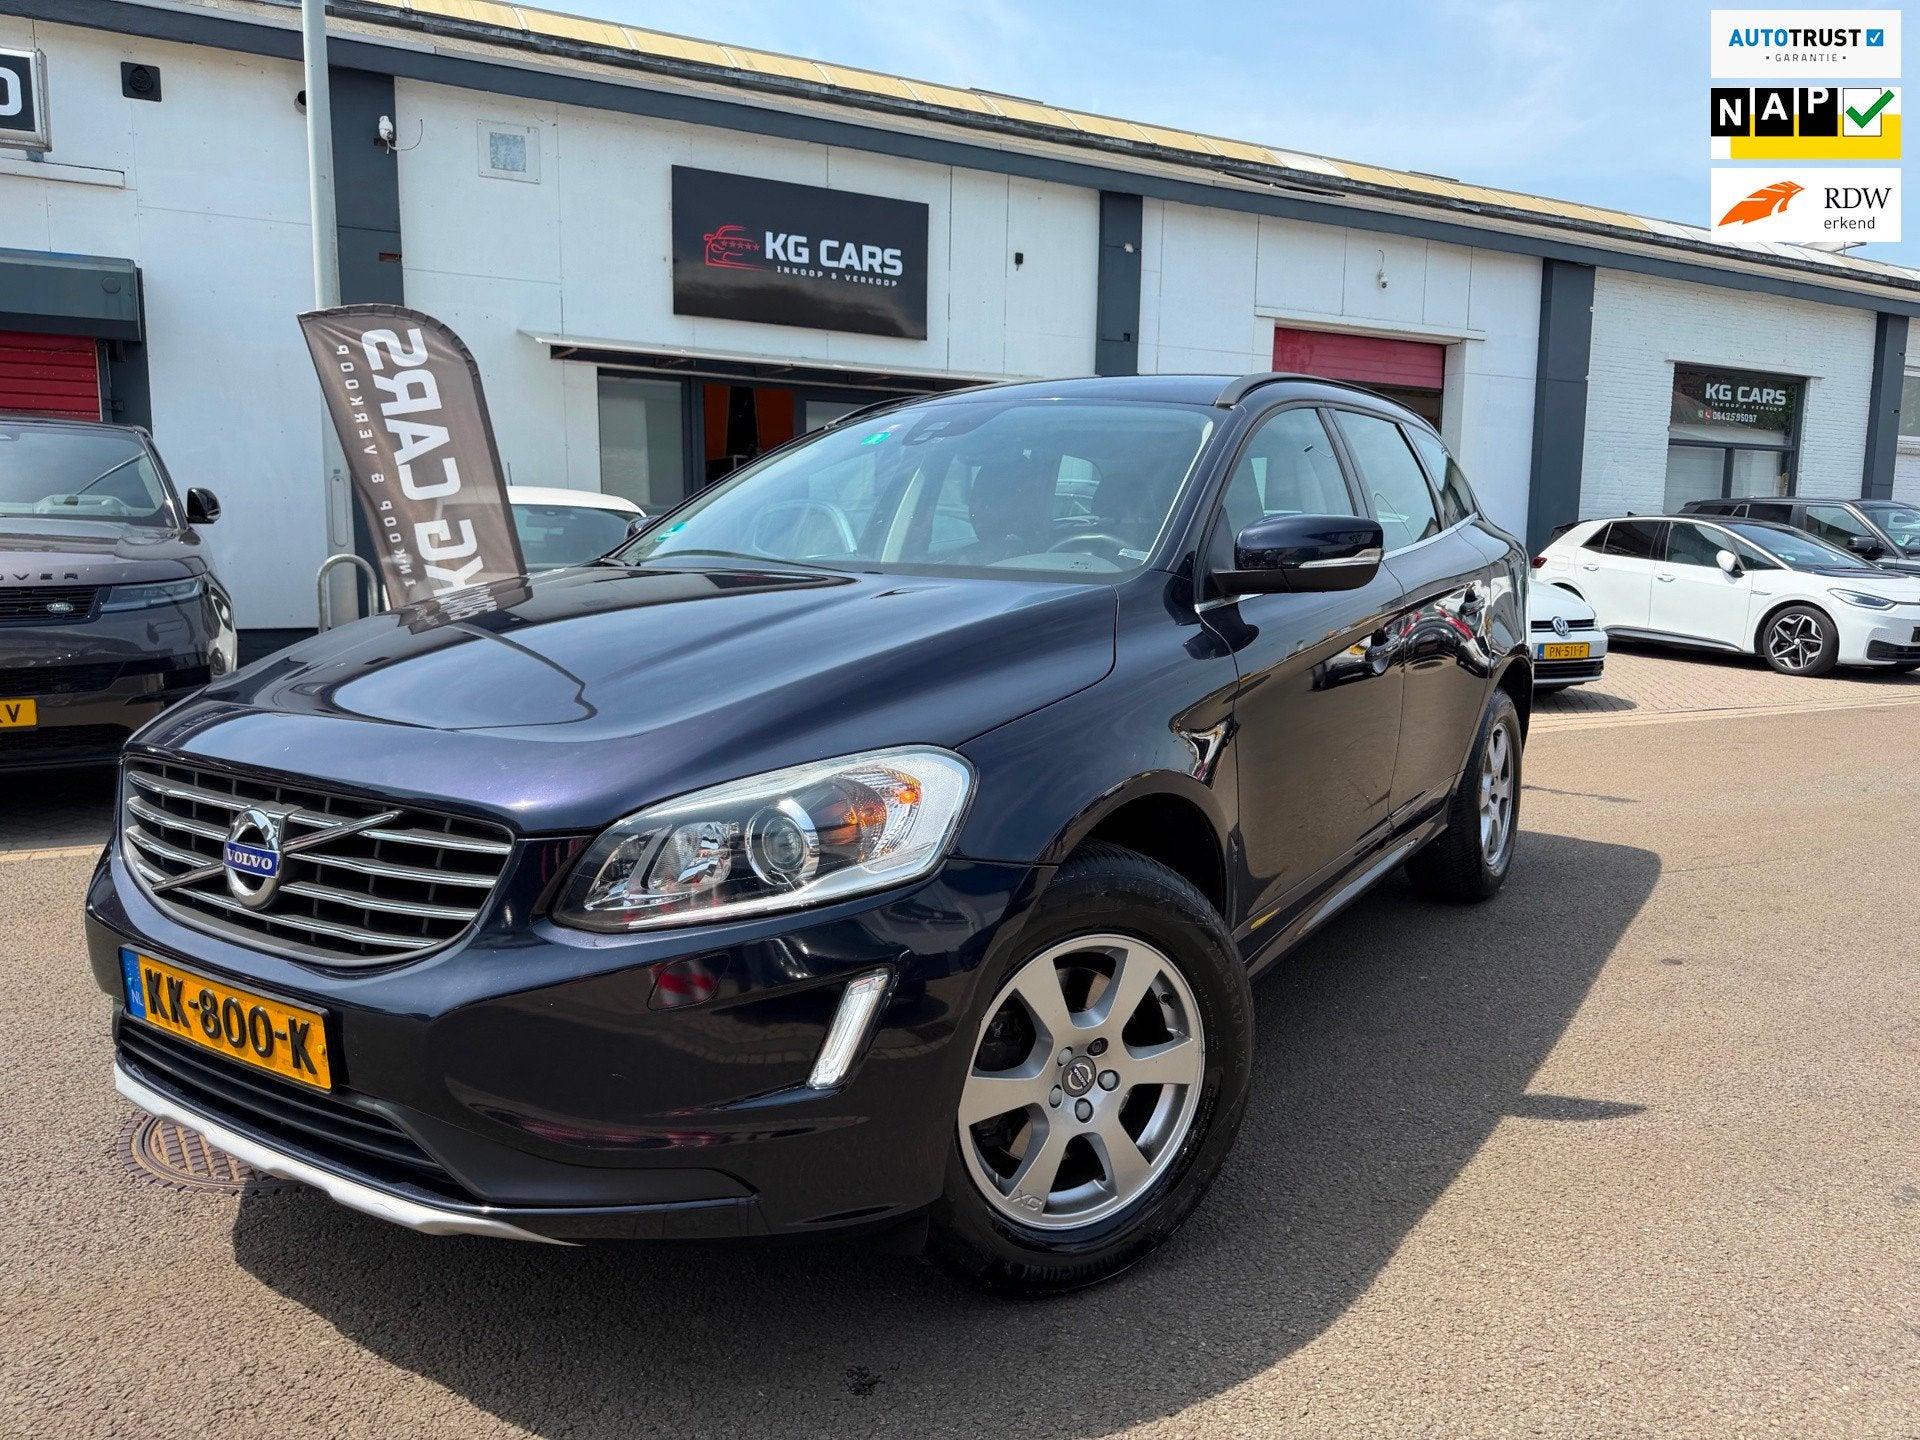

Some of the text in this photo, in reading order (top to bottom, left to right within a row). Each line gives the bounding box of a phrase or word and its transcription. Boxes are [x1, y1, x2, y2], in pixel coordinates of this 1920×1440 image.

[765, 231, 903, 276] KG CARS
[776, 265, 898, 287] INKOOP & VERKOOP
[1705, 383, 1786, 405] KG CARS
[226, 847, 273, 870] VOLVO
[131, 988, 145, 1007] NL
[145, 967, 318, 1075] KK-800-K
